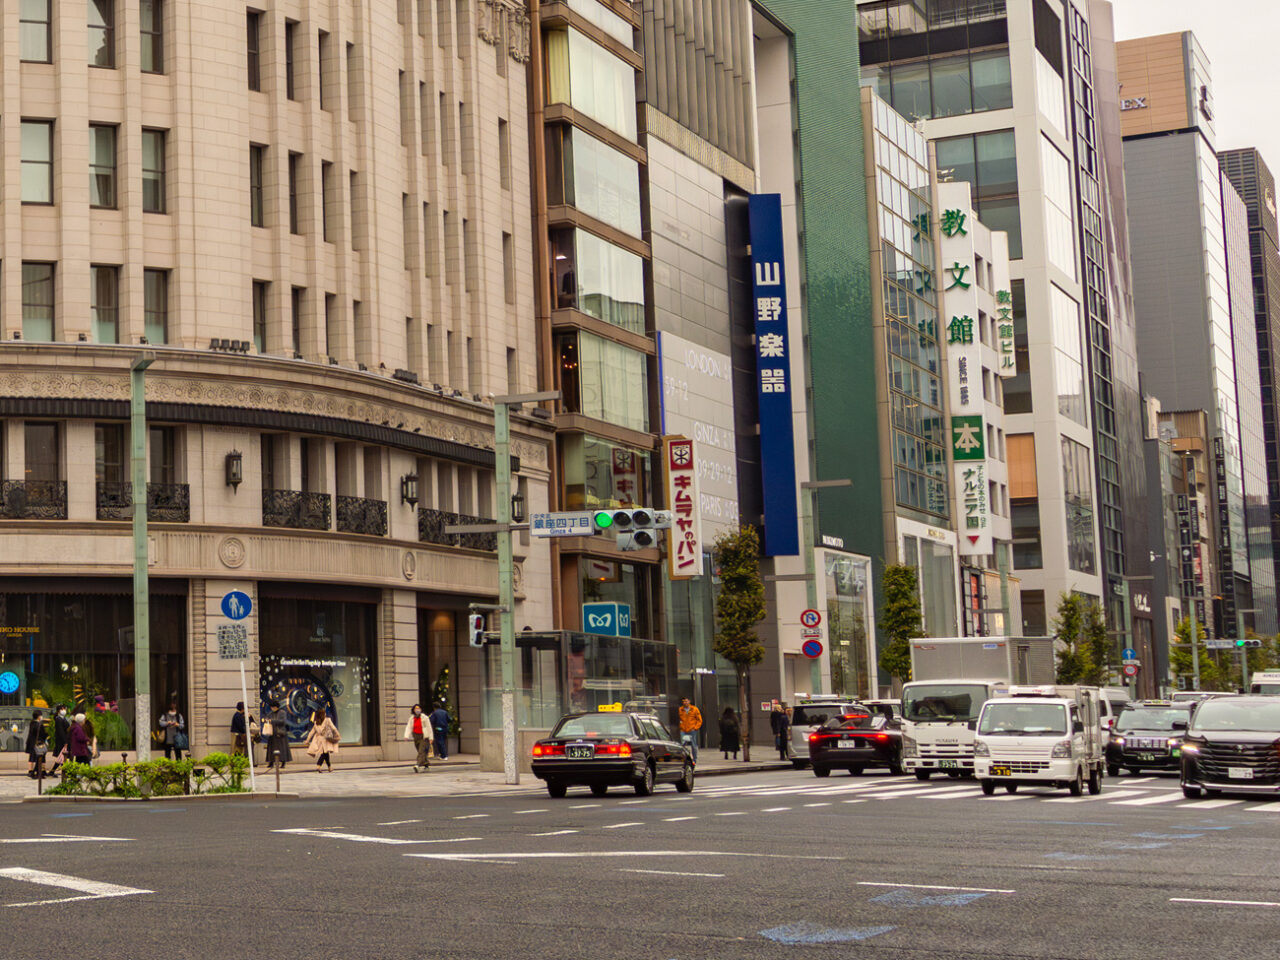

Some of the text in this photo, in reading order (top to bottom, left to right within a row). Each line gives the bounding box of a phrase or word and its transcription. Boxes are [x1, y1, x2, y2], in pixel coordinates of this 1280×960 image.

[940, 208, 974, 345] 教文館
[755, 262, 785, 393] 山野楽器
[996, 290, 1014, 369] 教文館ビル
[684, 349, 721, 377] LONDON
[694, 421, 720, 447] GINZA
[953, 422, 981, 453] 本
[701, 492, 722, 517] PARIS
[963, 468, 980, 529] ナルニア国
[534, 517, 589, 529] 銀座四丁目
[674, 475, 697, 569] キムラヤのパン
